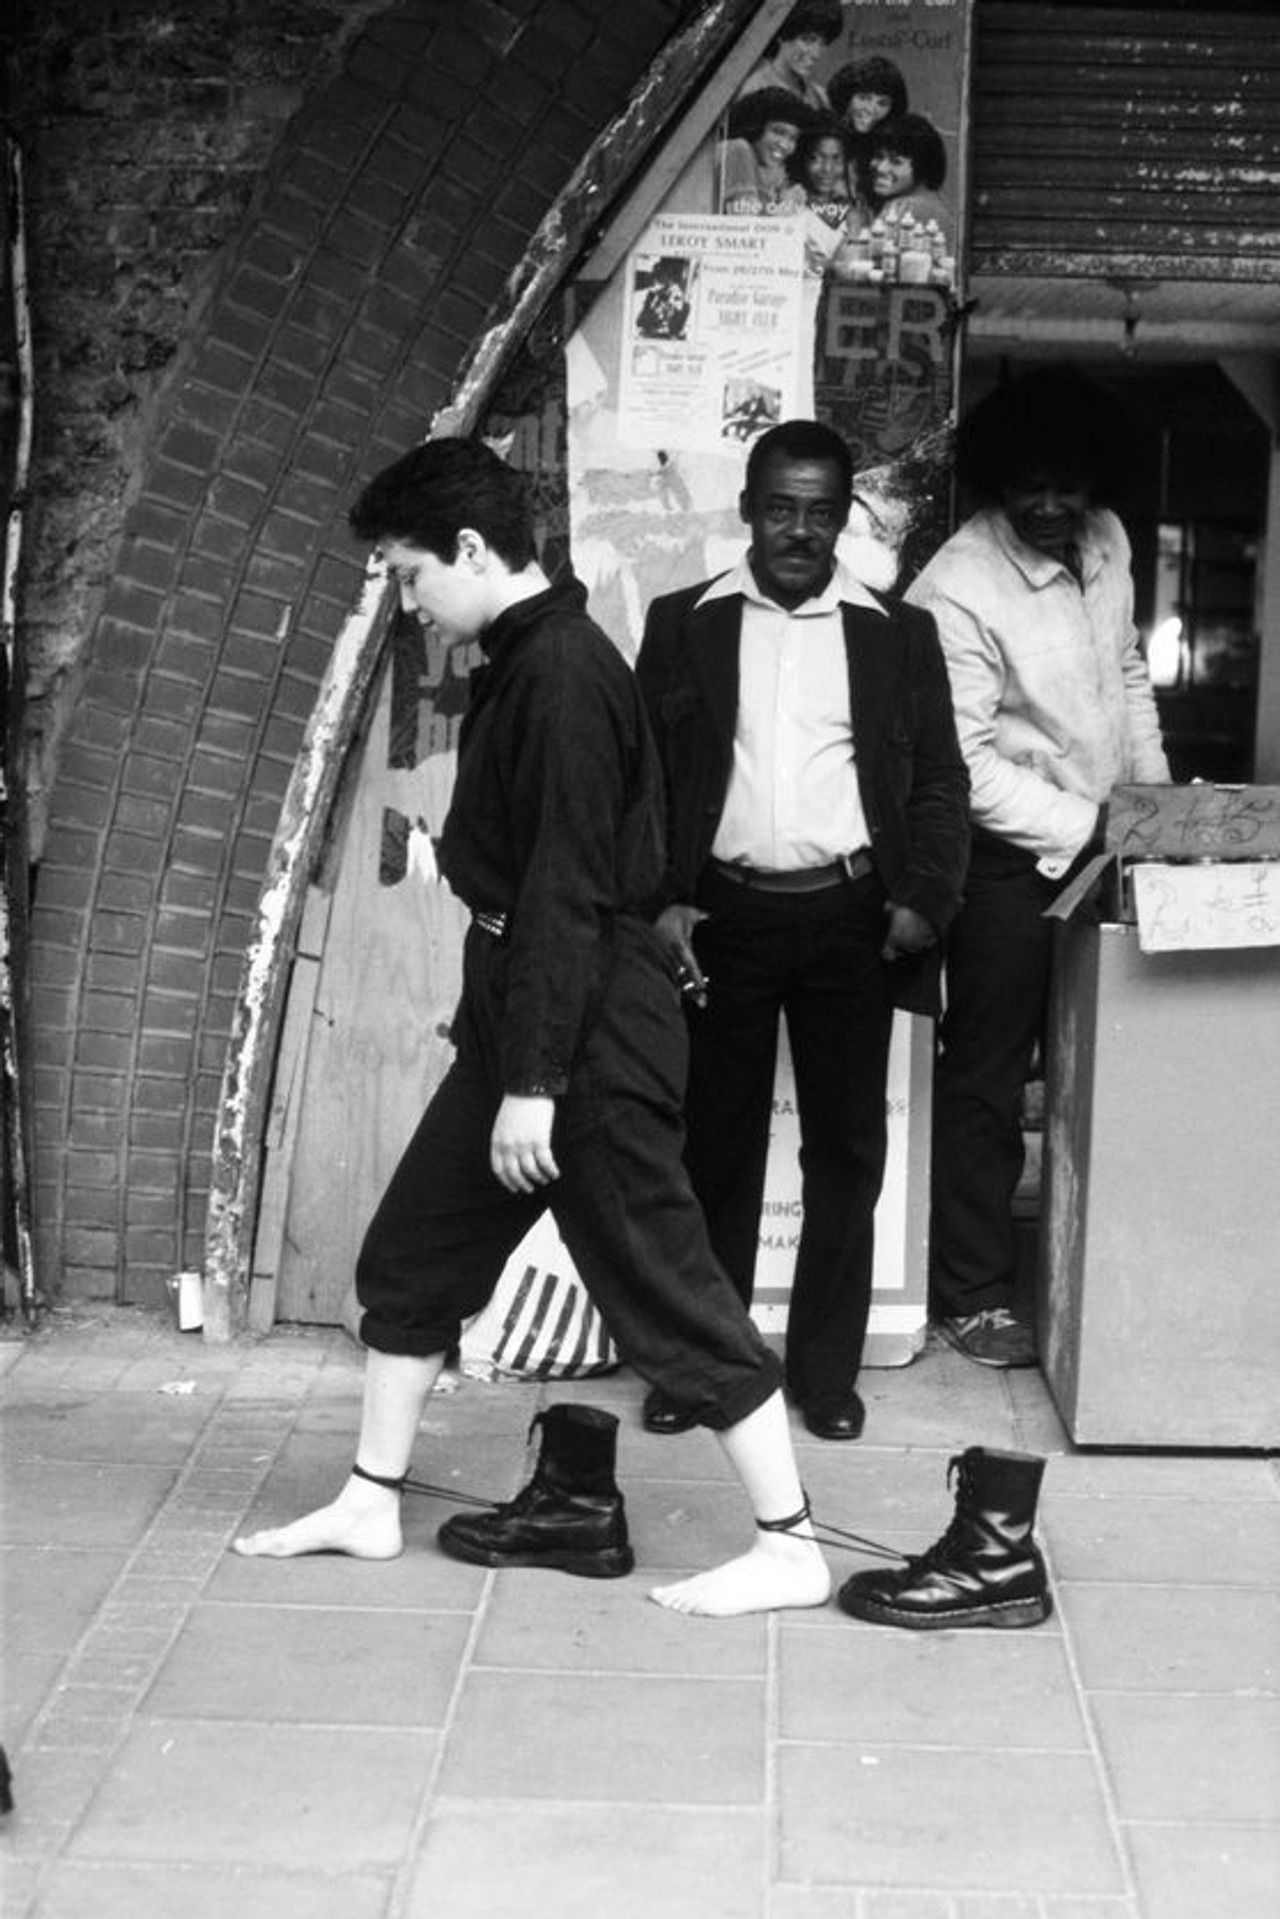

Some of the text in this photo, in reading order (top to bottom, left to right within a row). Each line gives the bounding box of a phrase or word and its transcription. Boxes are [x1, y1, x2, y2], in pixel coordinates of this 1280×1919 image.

[733, 197, 763, 214] the
[811, 203, 850, 221] way
[660, 234, 767, 251] LEROY SMART
[825, 286, 948, 363] ER
